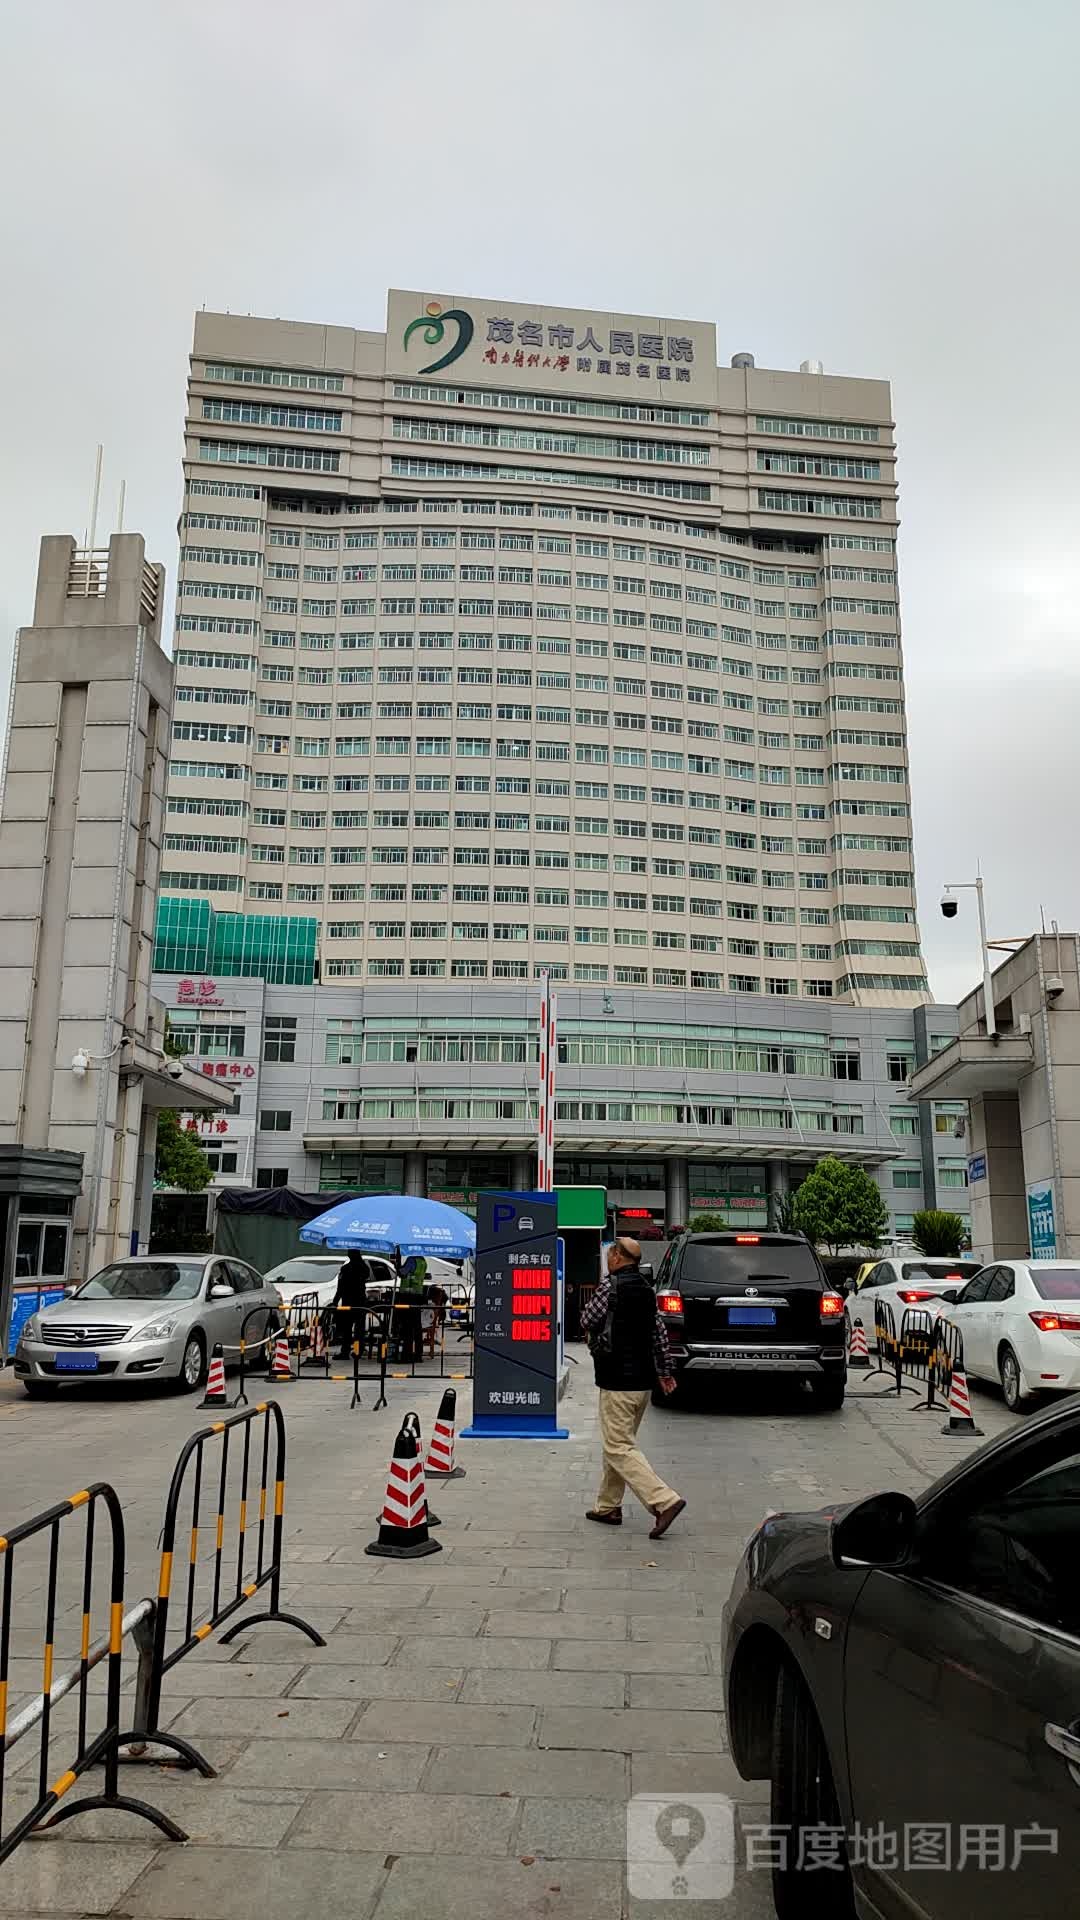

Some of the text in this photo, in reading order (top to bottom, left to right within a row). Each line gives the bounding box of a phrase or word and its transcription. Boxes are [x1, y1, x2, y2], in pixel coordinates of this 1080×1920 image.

[487, 317, 695, 362] 茂名市人民医院
[178, 979, 216, 996] 急诊
[493, 1204, 516, 1232] P
[508, 1253, 551, 1265] 剩余车位
[488, 1392, 541, 1405] 欢迎光临
